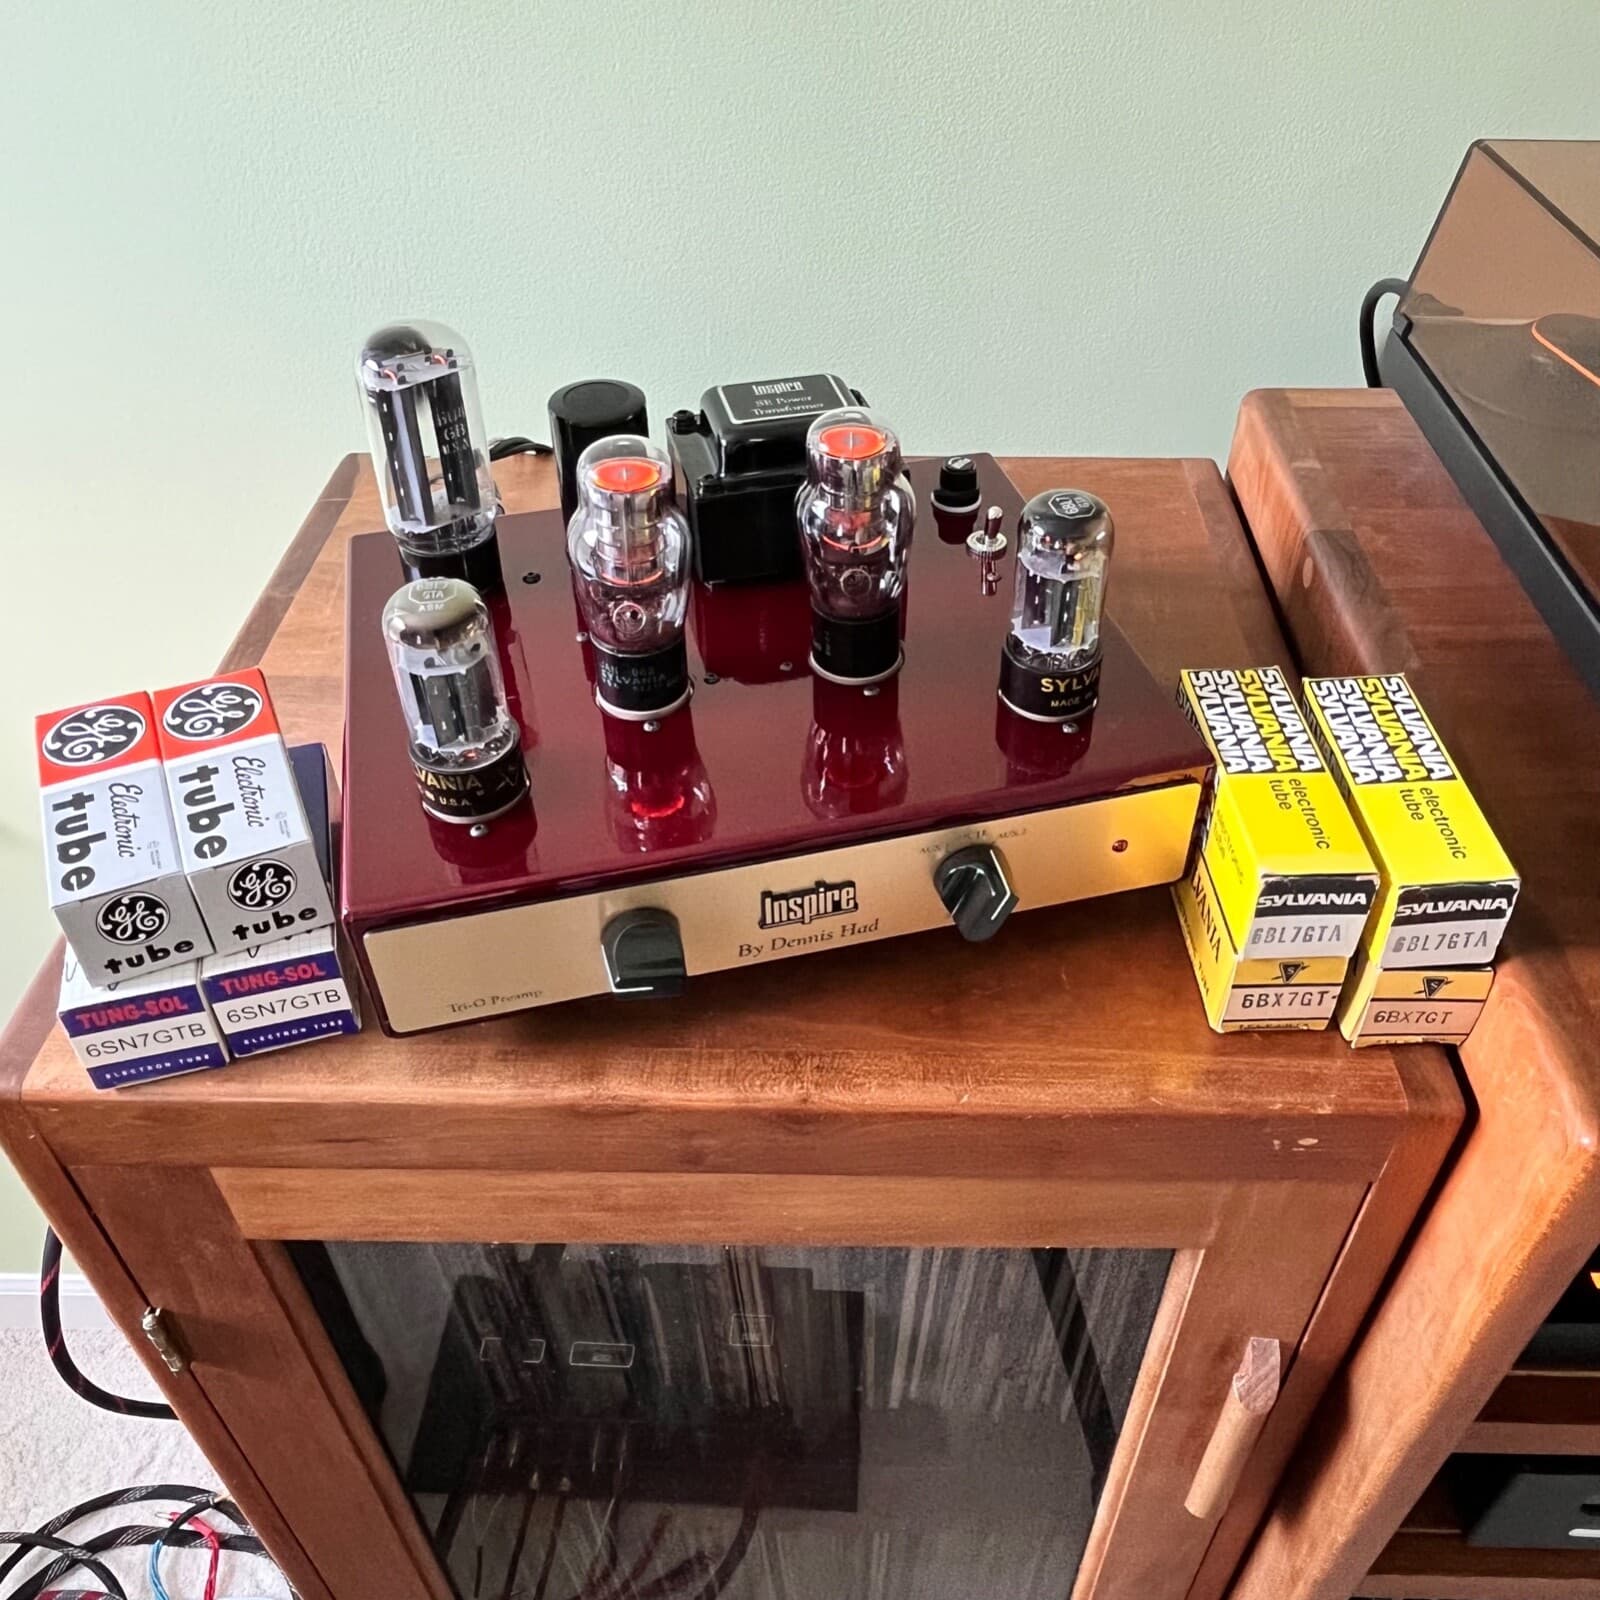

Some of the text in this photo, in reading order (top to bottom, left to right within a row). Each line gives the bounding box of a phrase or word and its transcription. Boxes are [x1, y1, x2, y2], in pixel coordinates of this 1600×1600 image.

[776, 395, 812, 405] Power
[1190, 671, 1249, 774] SYLVANIA
[1213, 670, 1274, 773] SYLVANIA
[1235, 669, 1298, 773] SYLVANIA
[1257, 669, 1322, 772] SYLVANIA
[1310, 681, 1378, 785] SYLVANIA
[1334, 679, 1403, 782] SYLVANIA
[1357, 678, 1428, 781] SYLVANIA
[1380, 676, 1454, 780] SYLVANIA
[232, 755, 270, 828] Electronic
[1269, 779, 1292, 810] tube
[1400, 788, 1425, 821] tube
[108, 782, 143, 858] Electronic
[178, 764, 235, 860] tube
[1289, 778, 1330, 850] electronic
[1420, 787, 1467, 860] electronic
[52, 791, 107, 892] tube
[760, 881, 857, 928] Inspire
[1256, 892, 1367, 908] SYLVANIA
[1396, 897, 1509, 917] SYLVANIA
[232, 907, 318, 940] tube
[738, 918, 880, 958] By Dennis Had
[104, 940, 194, 974] tube
[219, 962, 328, 995] TUNG-SOL
[490, 990, 544, 1006] Preamp
[75, 995, 190, 1029] TUNG-SOL
[227, 989, 341, 1024] 6SN7GTB
[1373, 1010, 1453, 1025] 6BX7GT
[86, 1023, 207, 1058] 6SN7GTB
[243, 1018, 344, 1045] ELECTRON TUBE
[104, 1053, 210, 1079] ELECTRON TUBE
